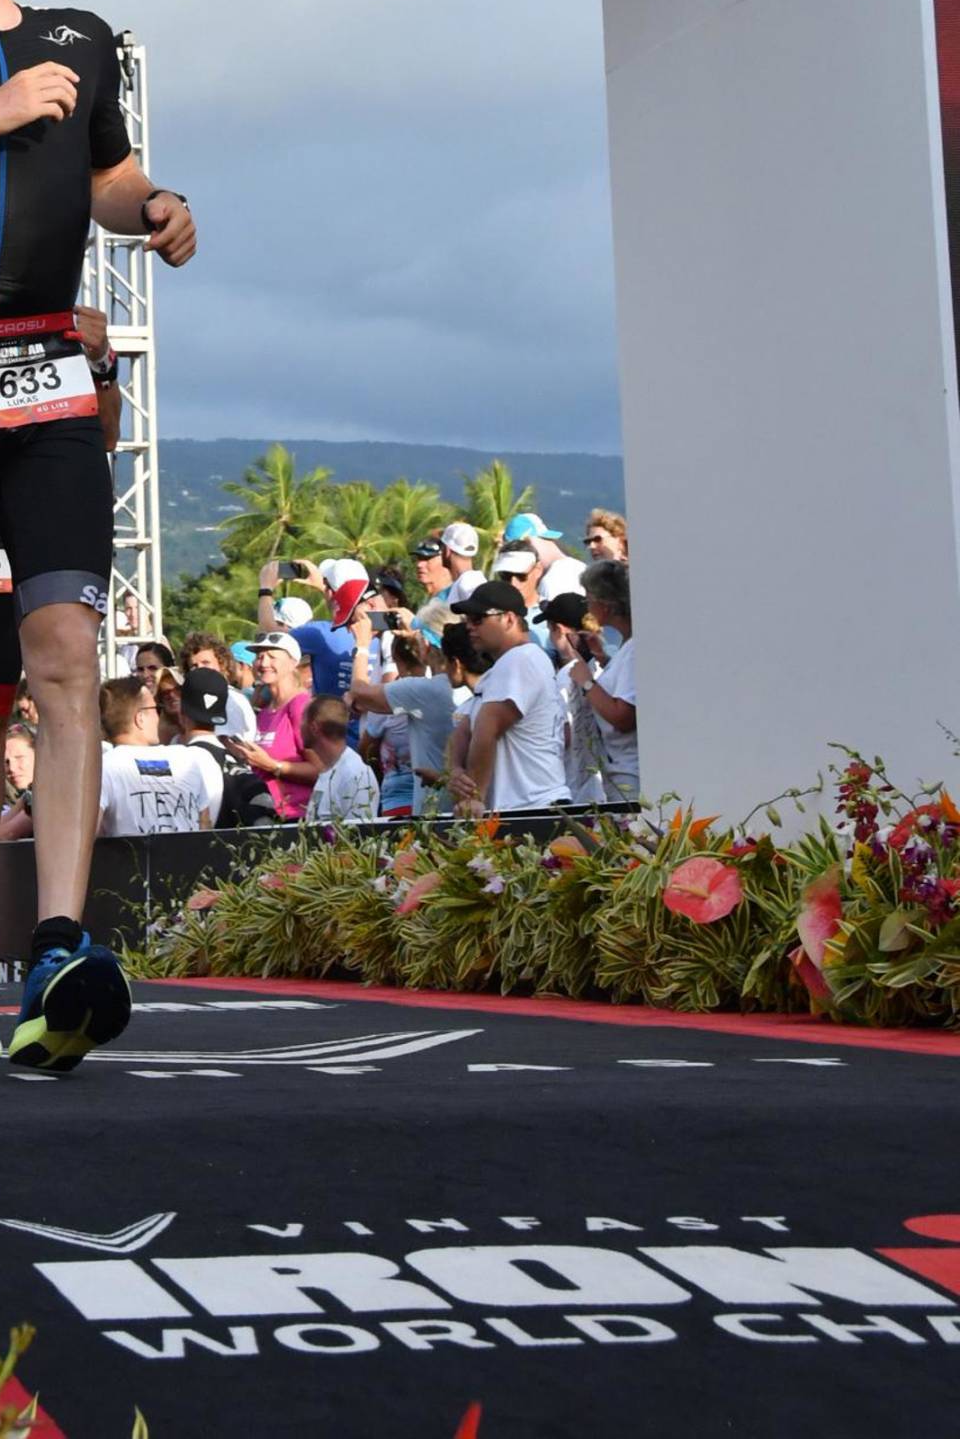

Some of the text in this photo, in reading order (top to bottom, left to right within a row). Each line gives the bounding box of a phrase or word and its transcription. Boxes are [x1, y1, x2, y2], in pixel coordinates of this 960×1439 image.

[7, 394, 39, 407] LUKAS
[246, 1216, 791, 1238] VINFAST
[33, 1244, 959, 1321] IRON
[101, 1314, 678, 1359] WORLD
